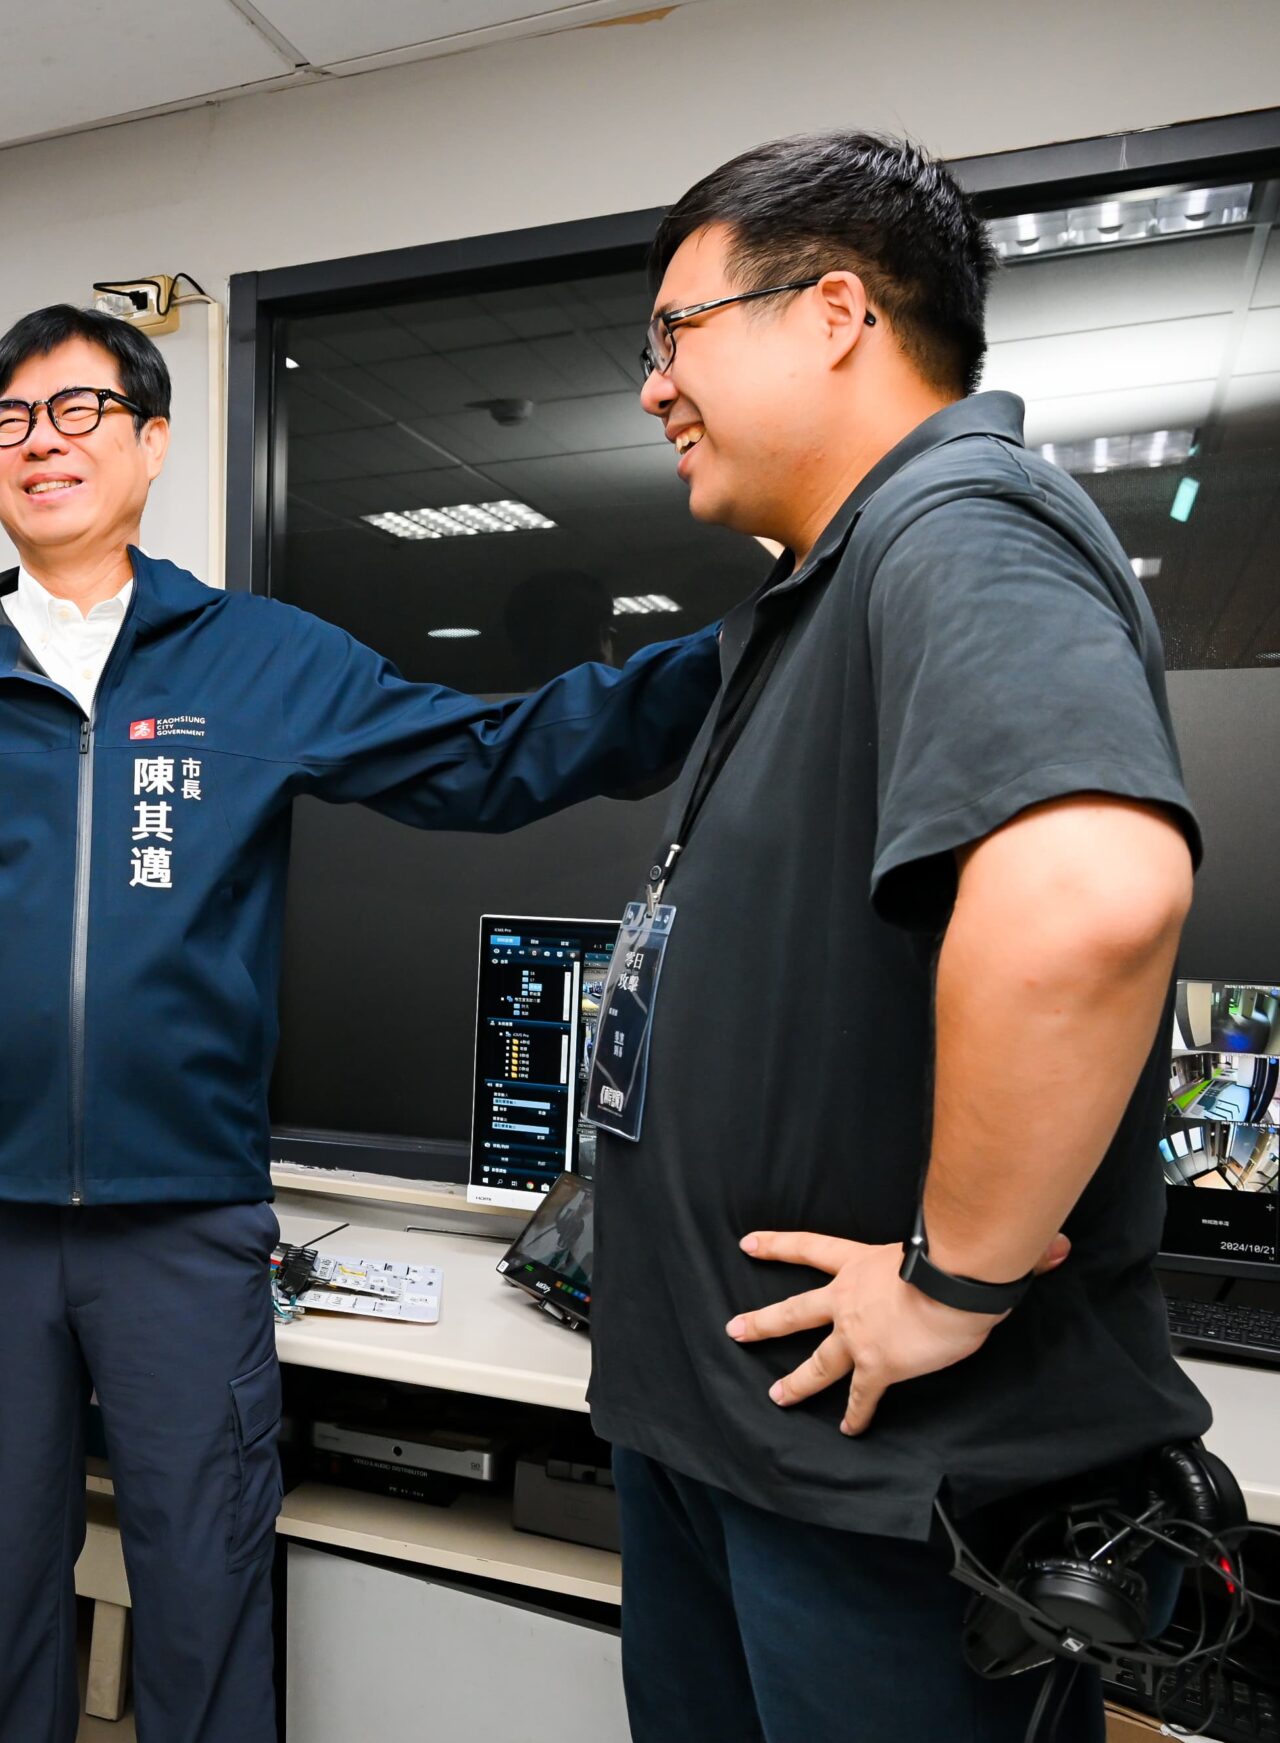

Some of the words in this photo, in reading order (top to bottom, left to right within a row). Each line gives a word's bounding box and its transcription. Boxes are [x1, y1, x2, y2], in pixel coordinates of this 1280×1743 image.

[157, 715, 206, 725] KAOHSIUNG
[157, 729, 206, 737] GOVERNMENT
[180, 757, 202, 801] 市長
[129, 755, 175, 888] 陳其邁
[625, 952, 644, 969] 零日
[617, 973, 639, 992] 攻擊
[1219, 1241, 1276, 1255] 2024/10/21
